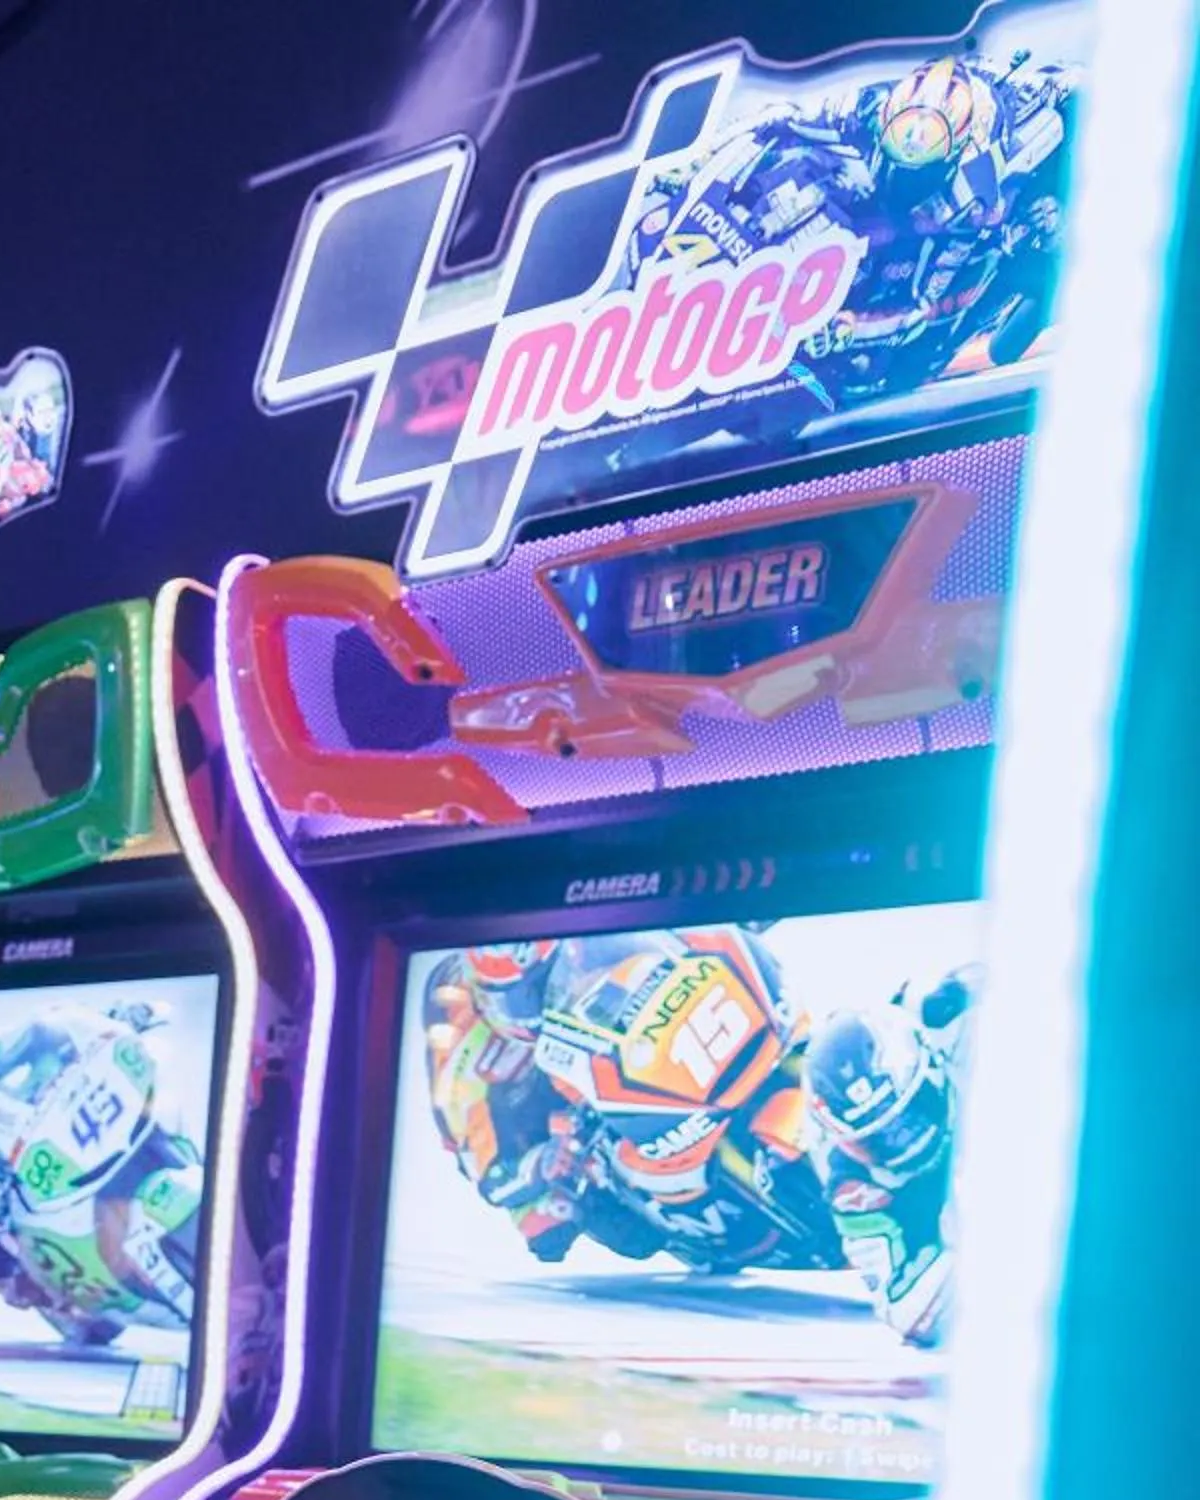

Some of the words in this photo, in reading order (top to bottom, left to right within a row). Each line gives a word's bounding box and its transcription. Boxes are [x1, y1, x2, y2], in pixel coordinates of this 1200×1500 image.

[630, 547, 822, 630] LEADER
[565, 872, 661, 903] CAMERA
[3, 937, 74, 962] CAMERA
[642, 958, 718, 1044] NGM
[669, 982, 751, 1089] 15
